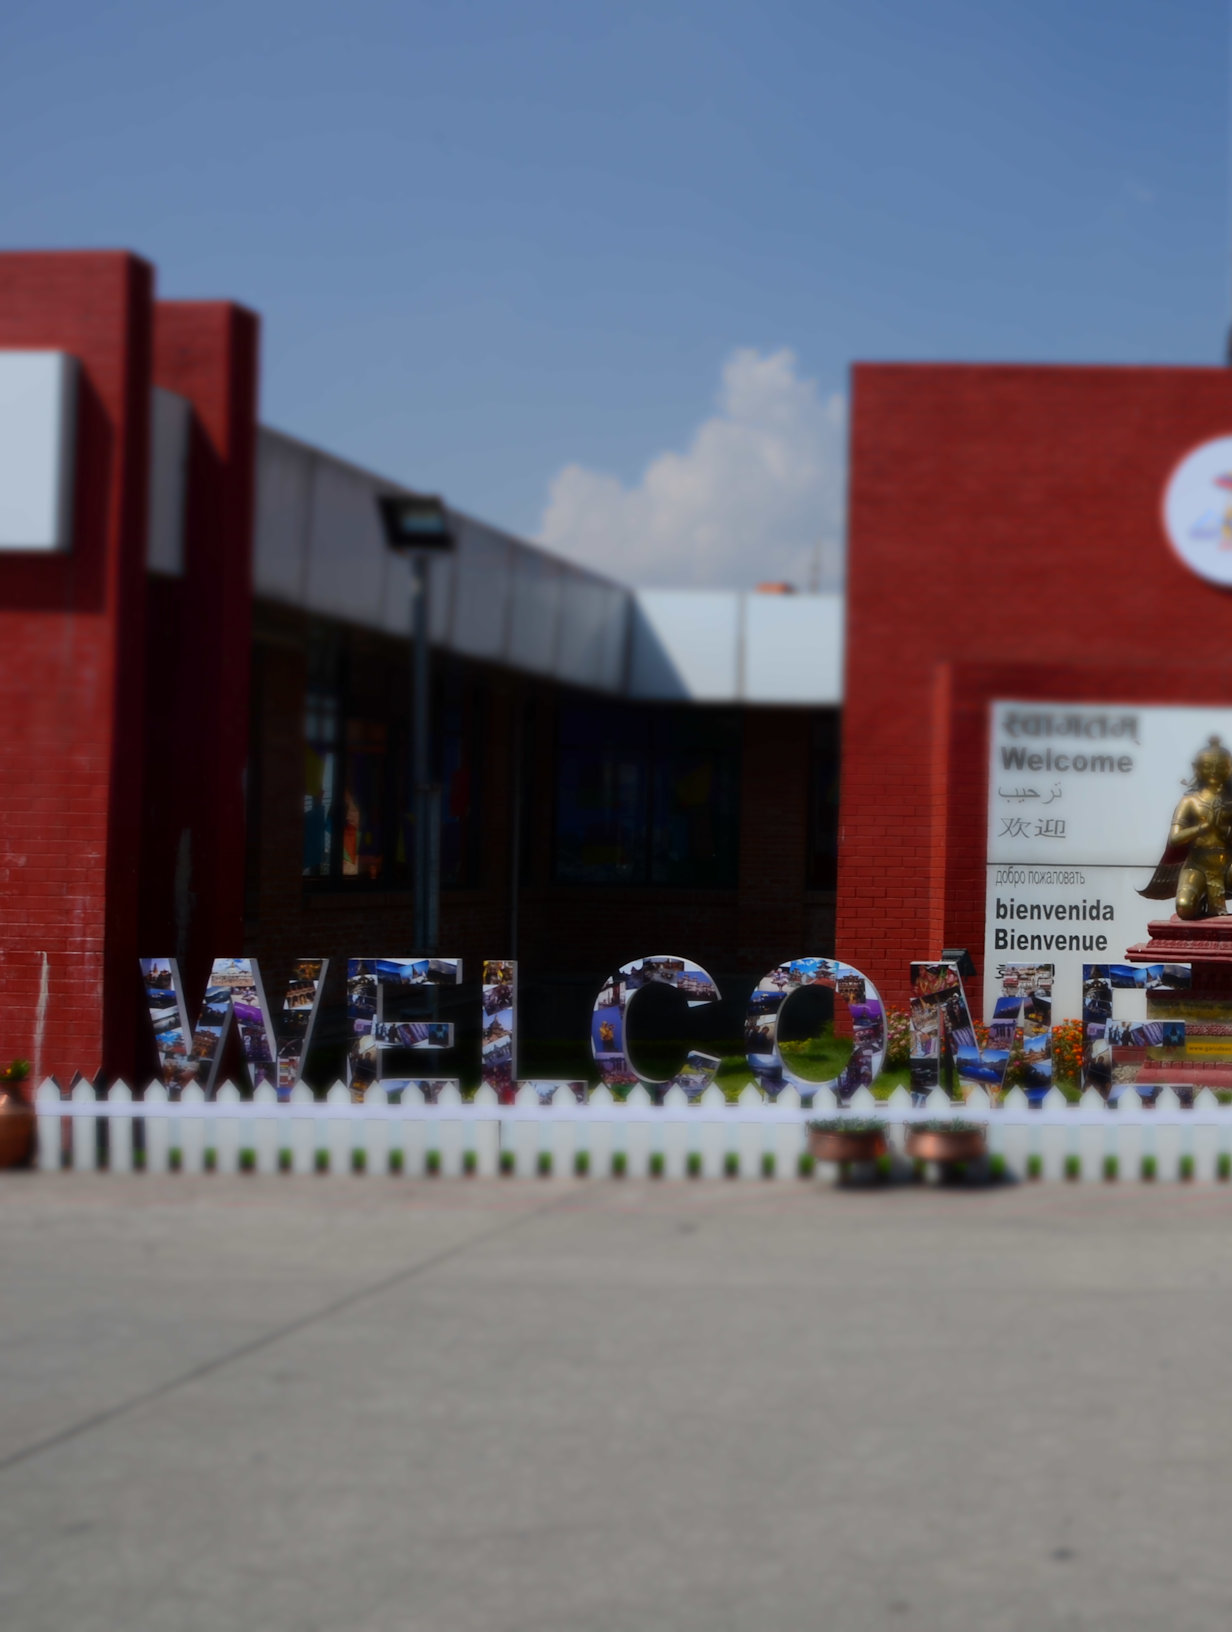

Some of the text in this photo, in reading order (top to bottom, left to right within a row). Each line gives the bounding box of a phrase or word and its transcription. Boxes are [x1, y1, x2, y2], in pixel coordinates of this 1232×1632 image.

[1001, 747, 1133, 773] Welcome
[998, 817, 1067, 839] 欢迎
[995, 866, 1086, 888] добро пожаловать
[995, 898, 1115, 922] bienvenida
[994, 928, 1109, 951] Bienvenue
[139, 955, 1193, 1108] WELCOME
